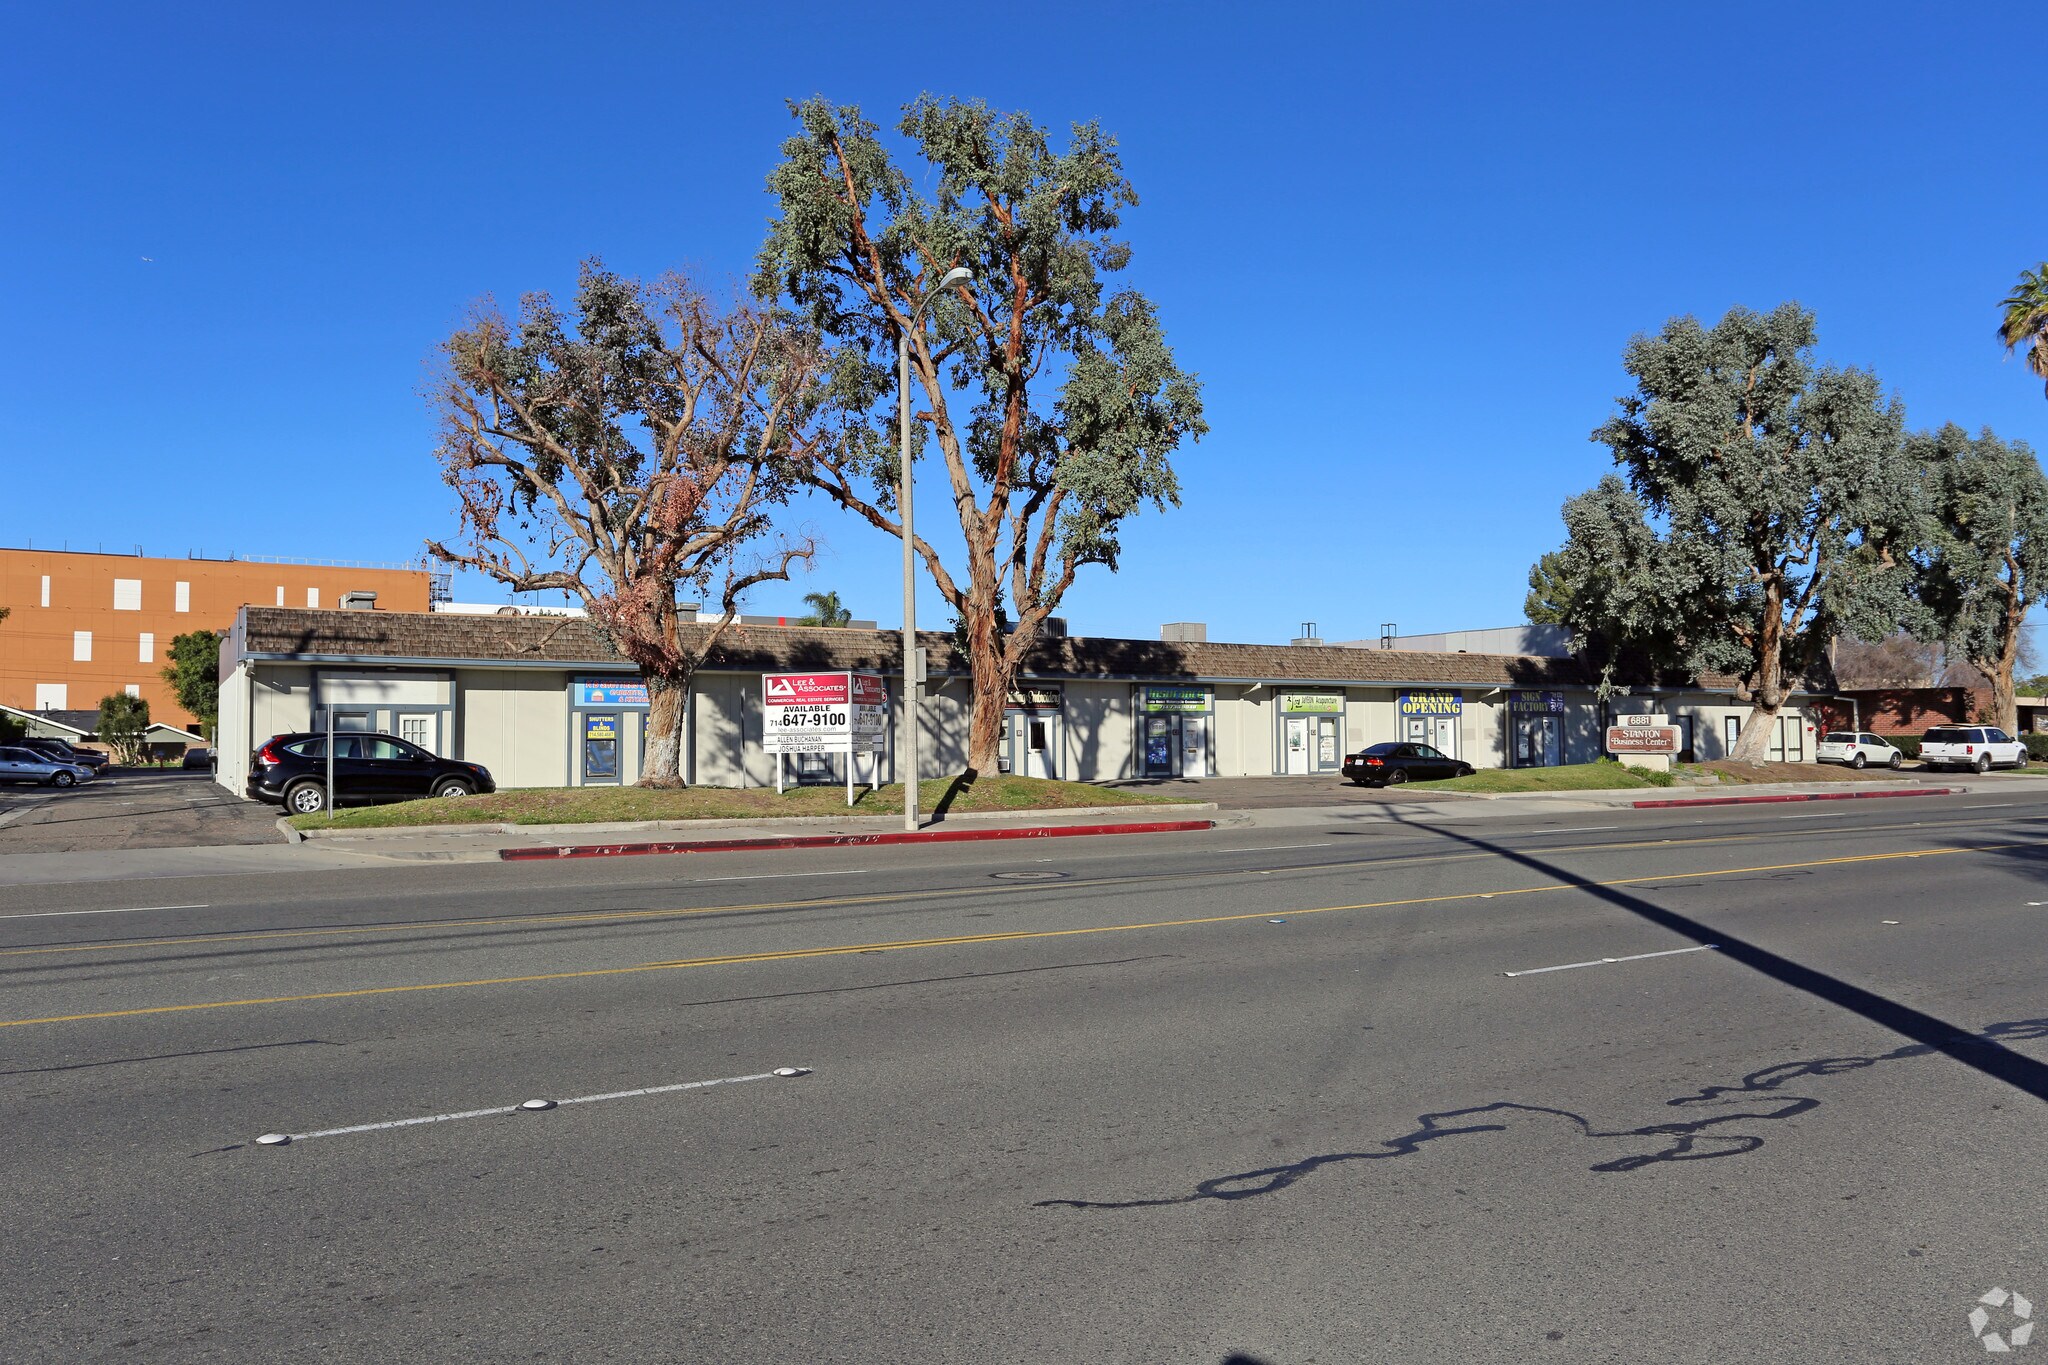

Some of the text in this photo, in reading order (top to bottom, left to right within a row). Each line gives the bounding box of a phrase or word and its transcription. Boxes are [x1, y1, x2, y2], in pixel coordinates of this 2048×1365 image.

[1409, 691, 1454, 703] GRAND
[1521, 691, 1540, 701] SIGN
[1402, 702, 1460, 714] OPENING
[1513, 702, 1549, 711] FACTORY
[783, 713, 846, 726] 647-9100
[1630, 716, 1649, 724] 6881
[1623, 730, 1660, 738] STANTON
[1611, 737, 1643, 745] Business
